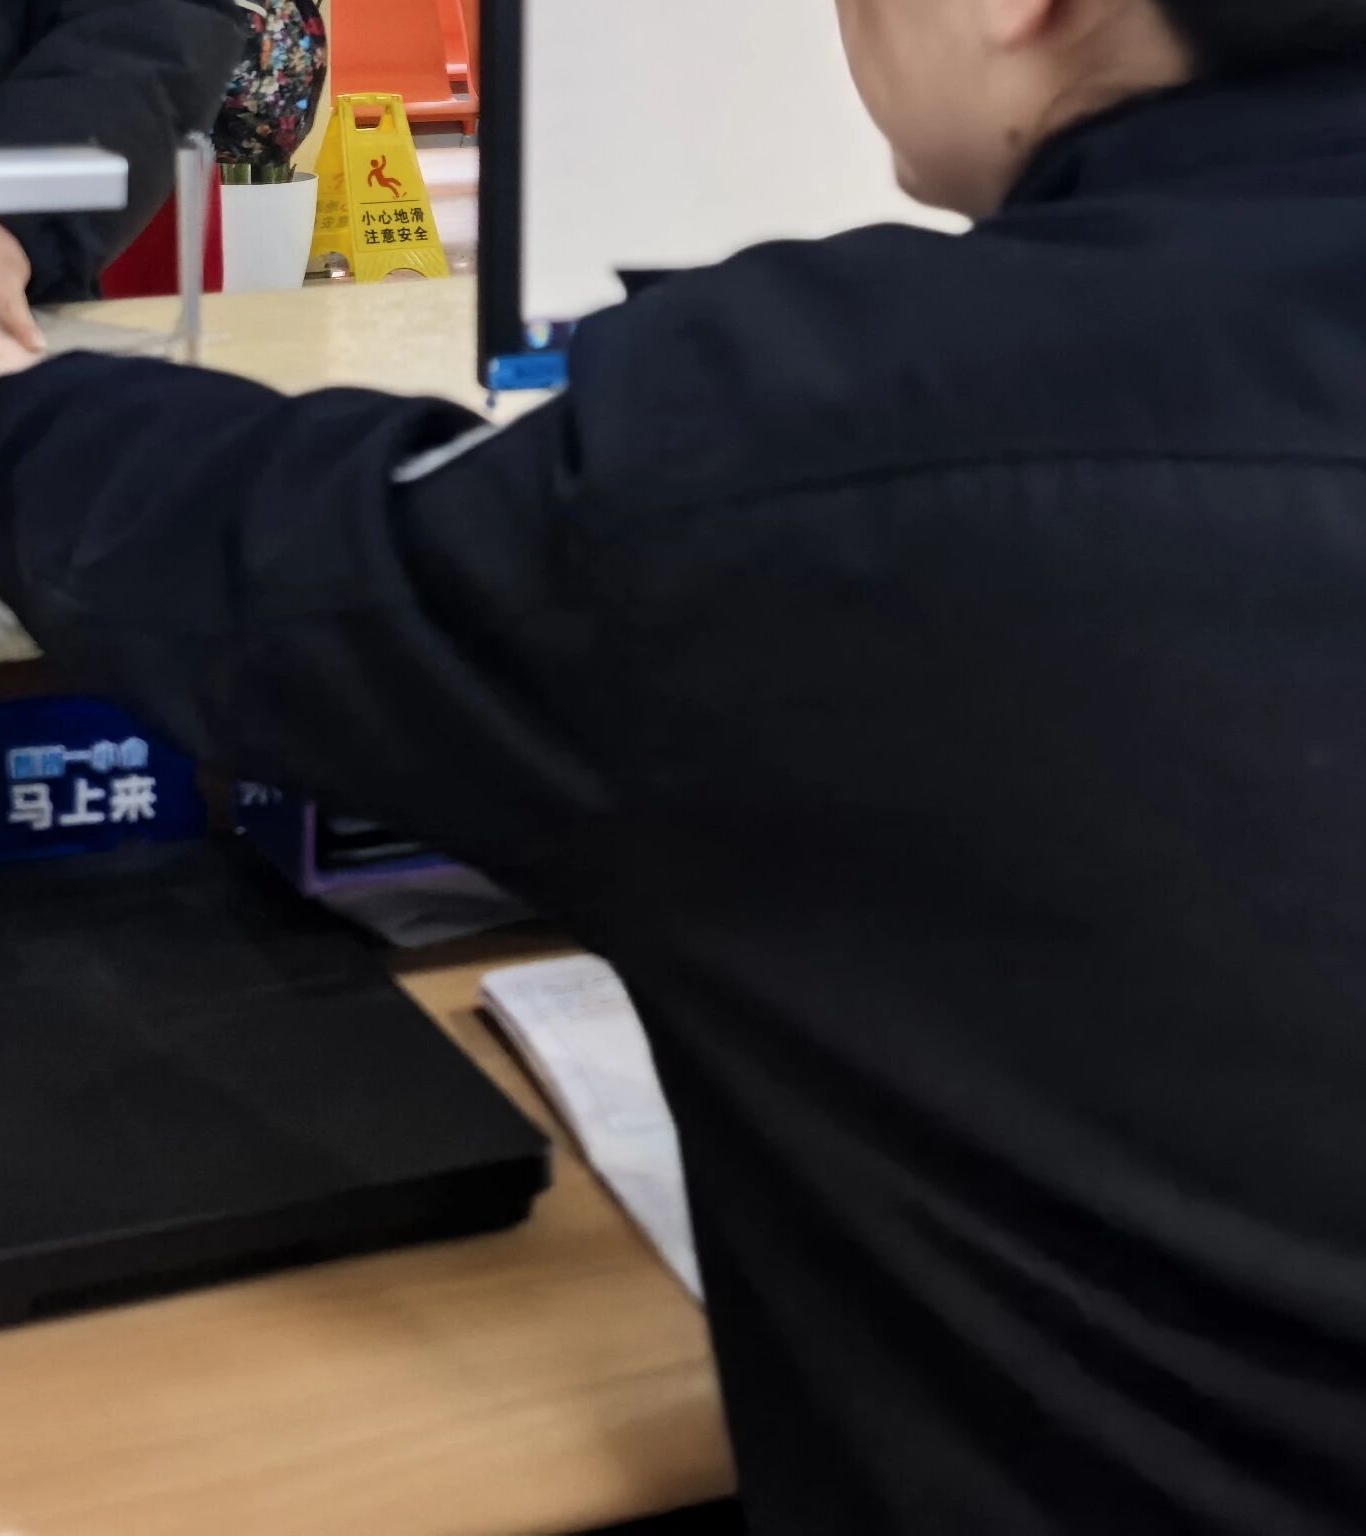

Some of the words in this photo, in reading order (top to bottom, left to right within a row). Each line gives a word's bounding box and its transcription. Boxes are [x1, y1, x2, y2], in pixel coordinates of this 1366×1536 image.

[362, 207, 424, 226] 小心地滑
[364, 225, 428, 244] 注意安全
[8, 774, 157, 831] 马上来
